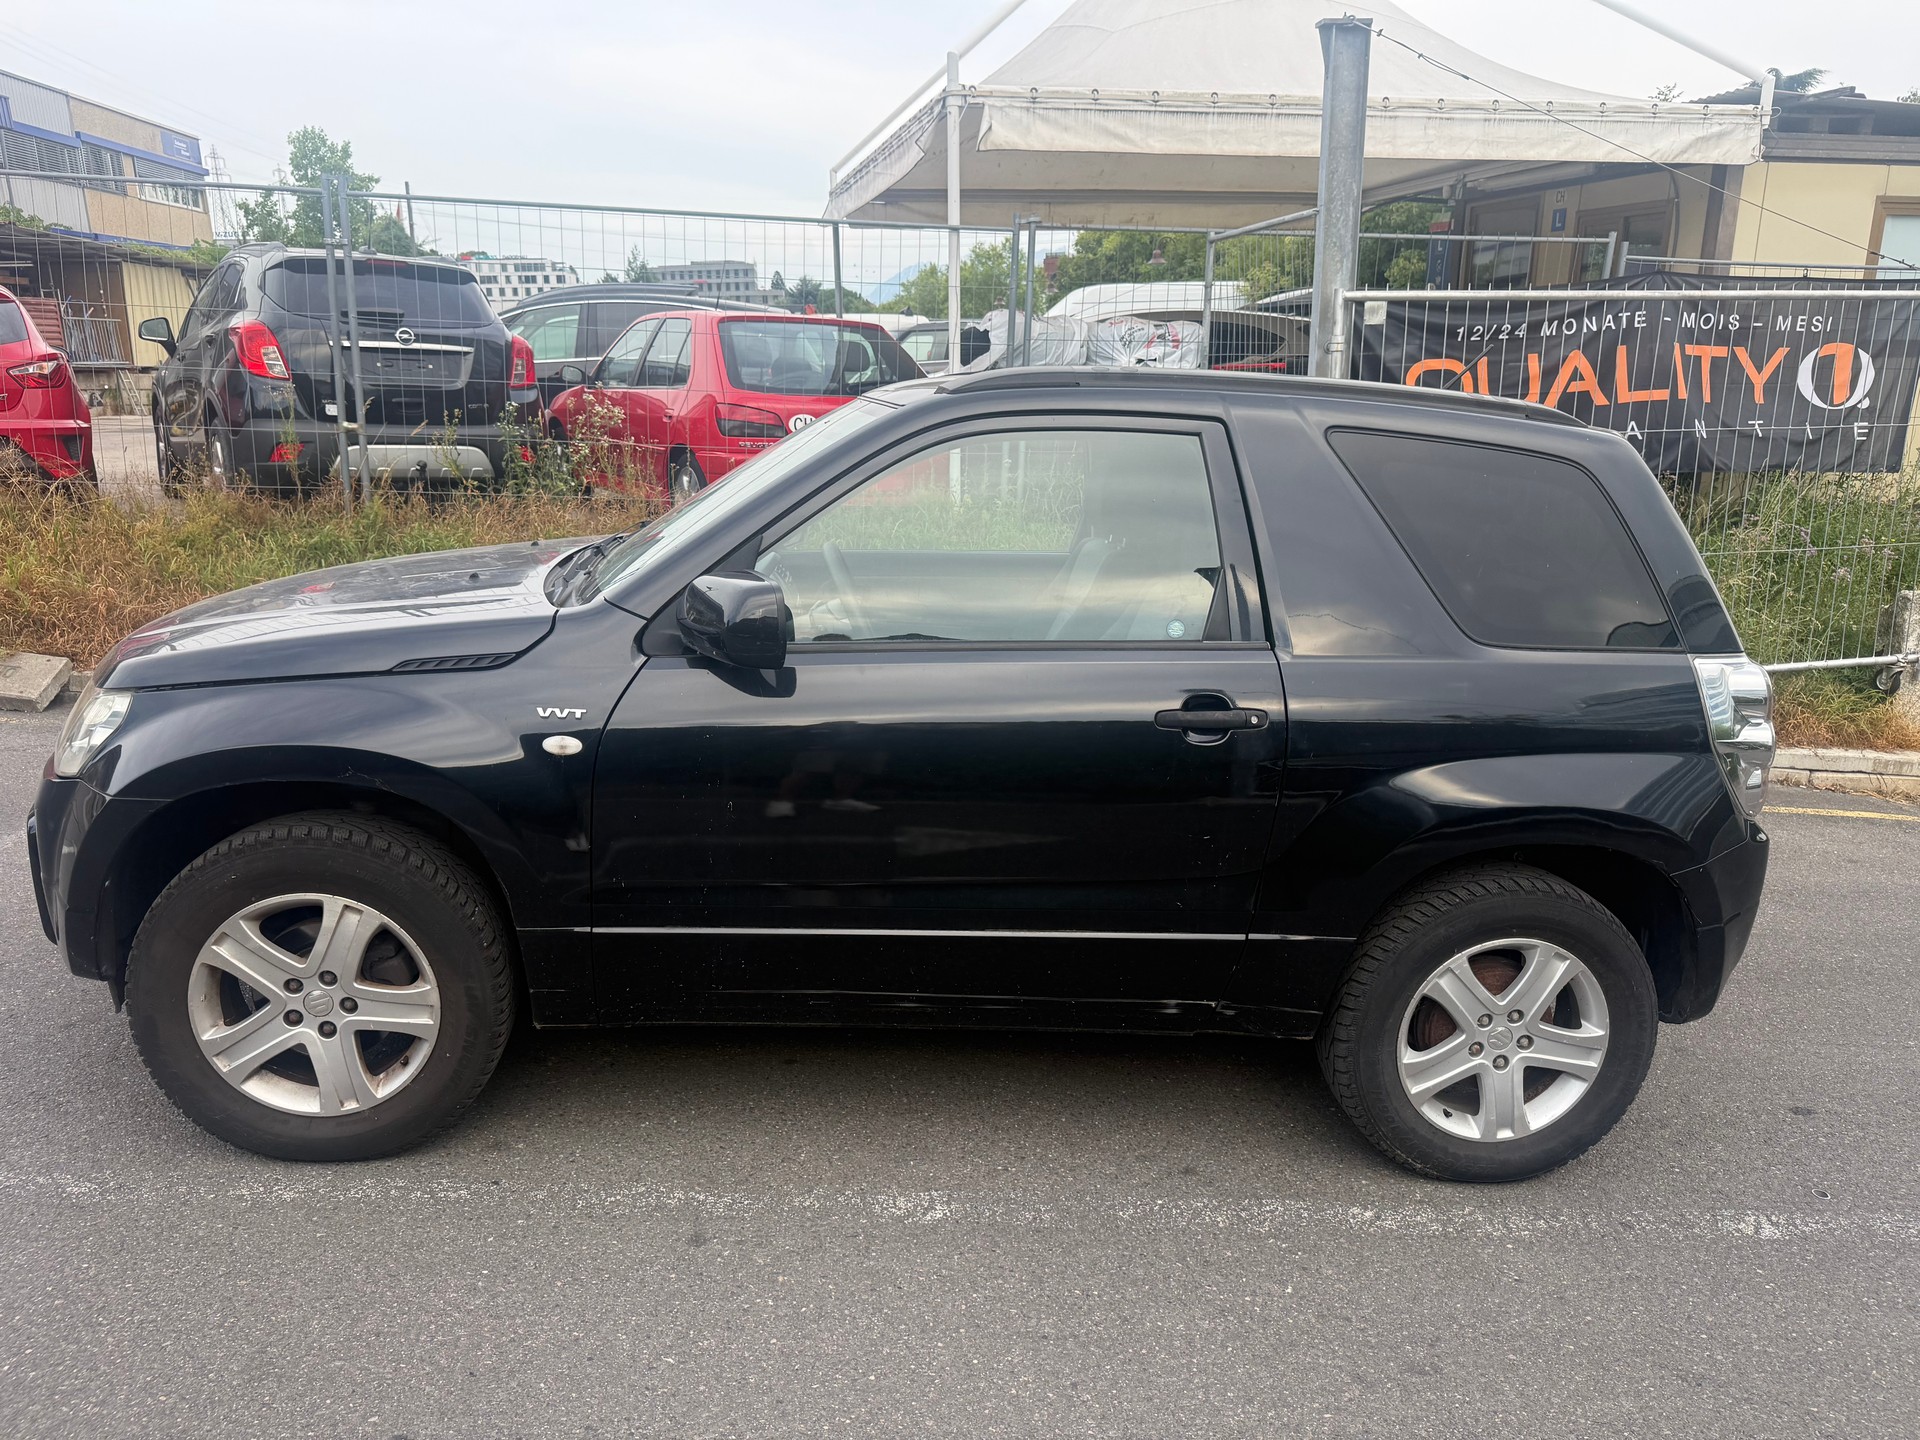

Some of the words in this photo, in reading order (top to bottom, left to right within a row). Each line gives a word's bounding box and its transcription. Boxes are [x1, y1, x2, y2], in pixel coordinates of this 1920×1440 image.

[1457, 322, 1527, 342] 12/24
[1541, 310, 1648, 336] MONATE
[1681, 311, 1740, 331] MOIS
[1776, 315, 1833, 332] MESI
[1624, 420, 1869, 441] ANTIE
[536, 707, 587, 719] VVT
